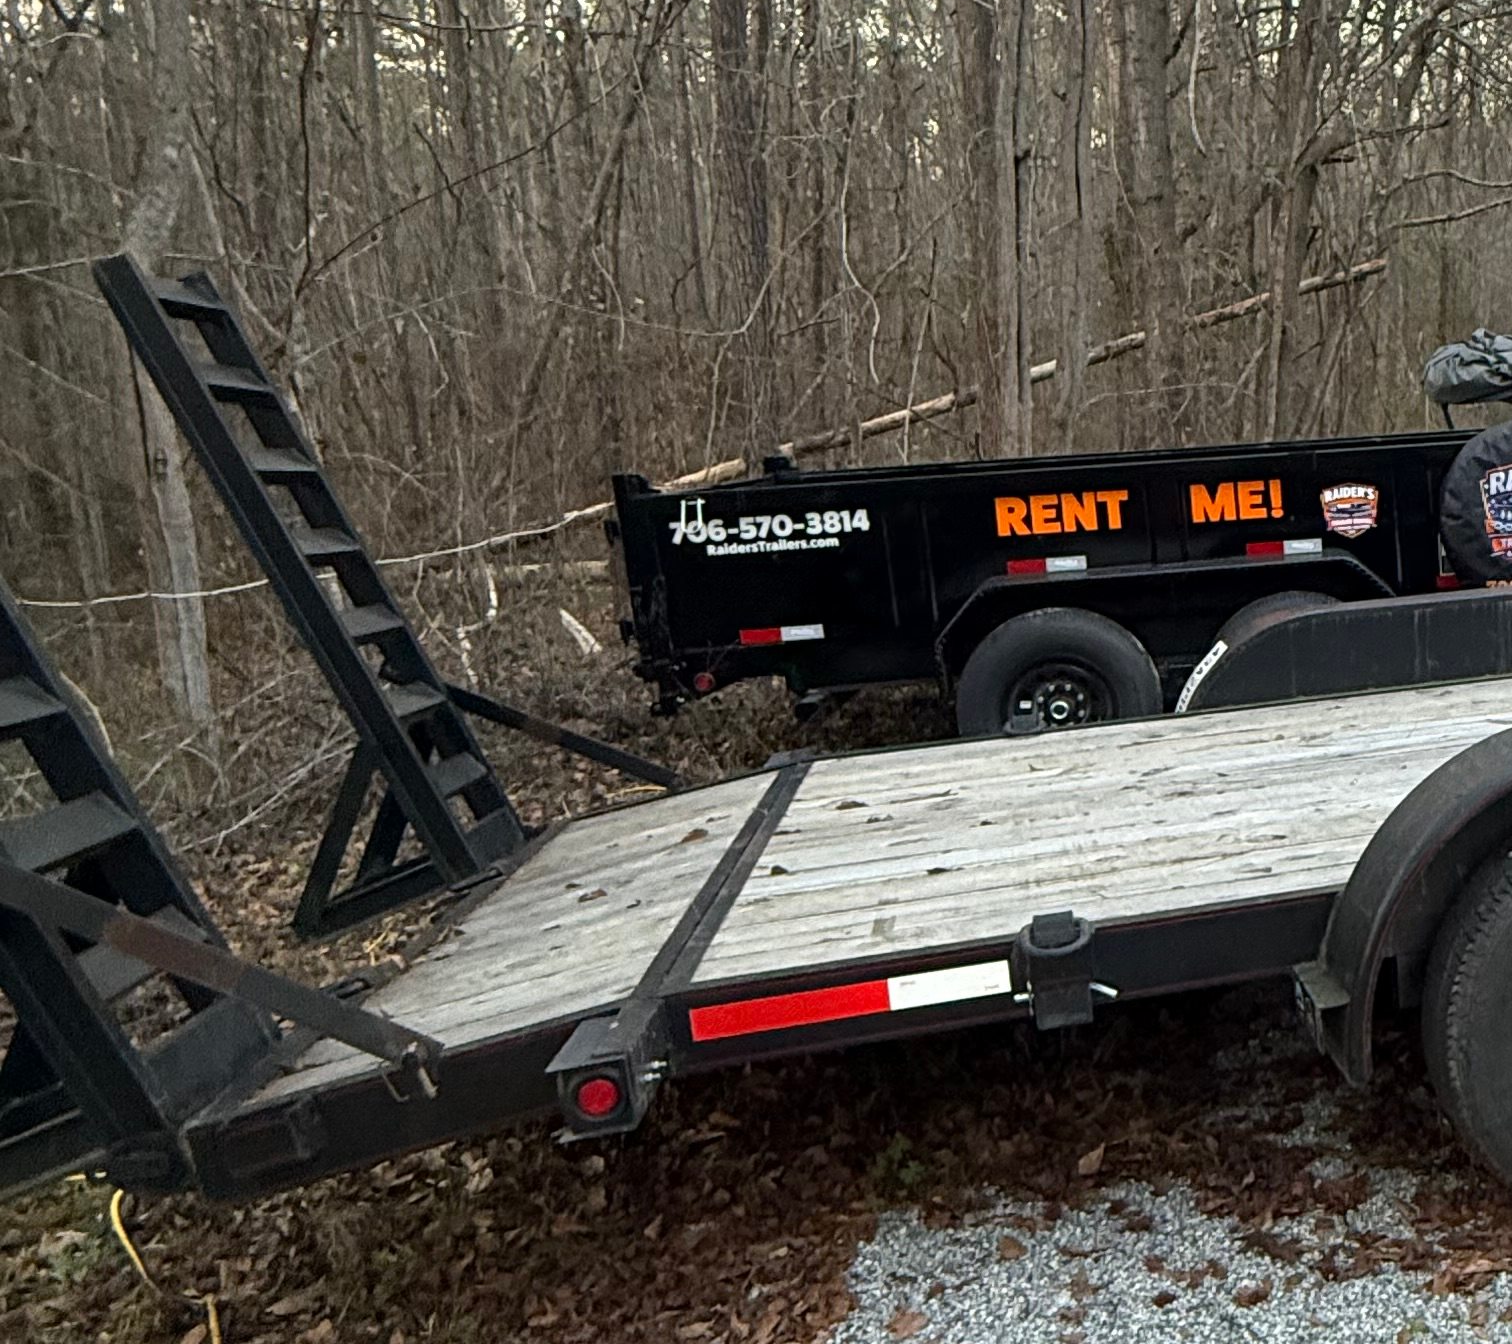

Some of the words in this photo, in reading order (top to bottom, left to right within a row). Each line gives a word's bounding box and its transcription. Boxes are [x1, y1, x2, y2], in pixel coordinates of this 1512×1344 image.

[994, 490, 1128, 537] RENT
[1190, 479, 1285, 524] ME!
[1324, 486, 1375, 503] RAIDER'S
[669, 509, 870, 545] 706-570-3814
[706, 537, 840, 556] RaidersTrailers.com
